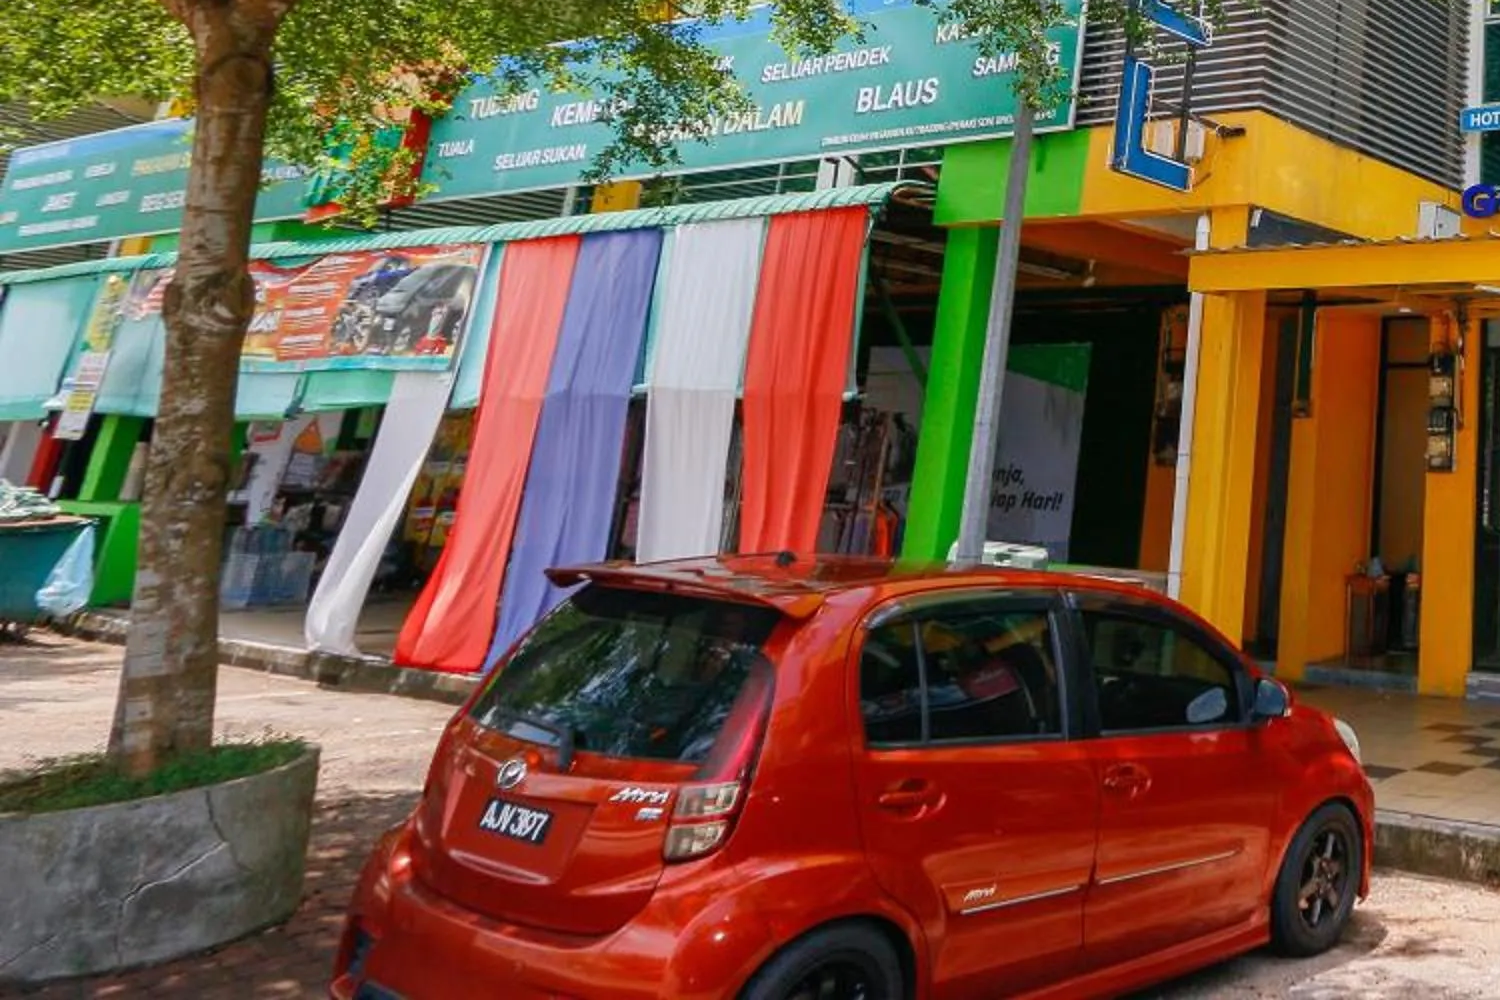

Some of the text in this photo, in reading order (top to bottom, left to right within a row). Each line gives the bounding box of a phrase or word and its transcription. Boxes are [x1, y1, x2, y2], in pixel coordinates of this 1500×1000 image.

[761, 55, 824, 84] SELUAR
[824, 46, 893, 72] PENDEK
[856, 77, 939, 113] BLAUS
[437, 139, 475, 158] TUALA
[493, 144, 587, 171] SELUAR SUKAN
[1020, 489, 1063, 512] Hari!
